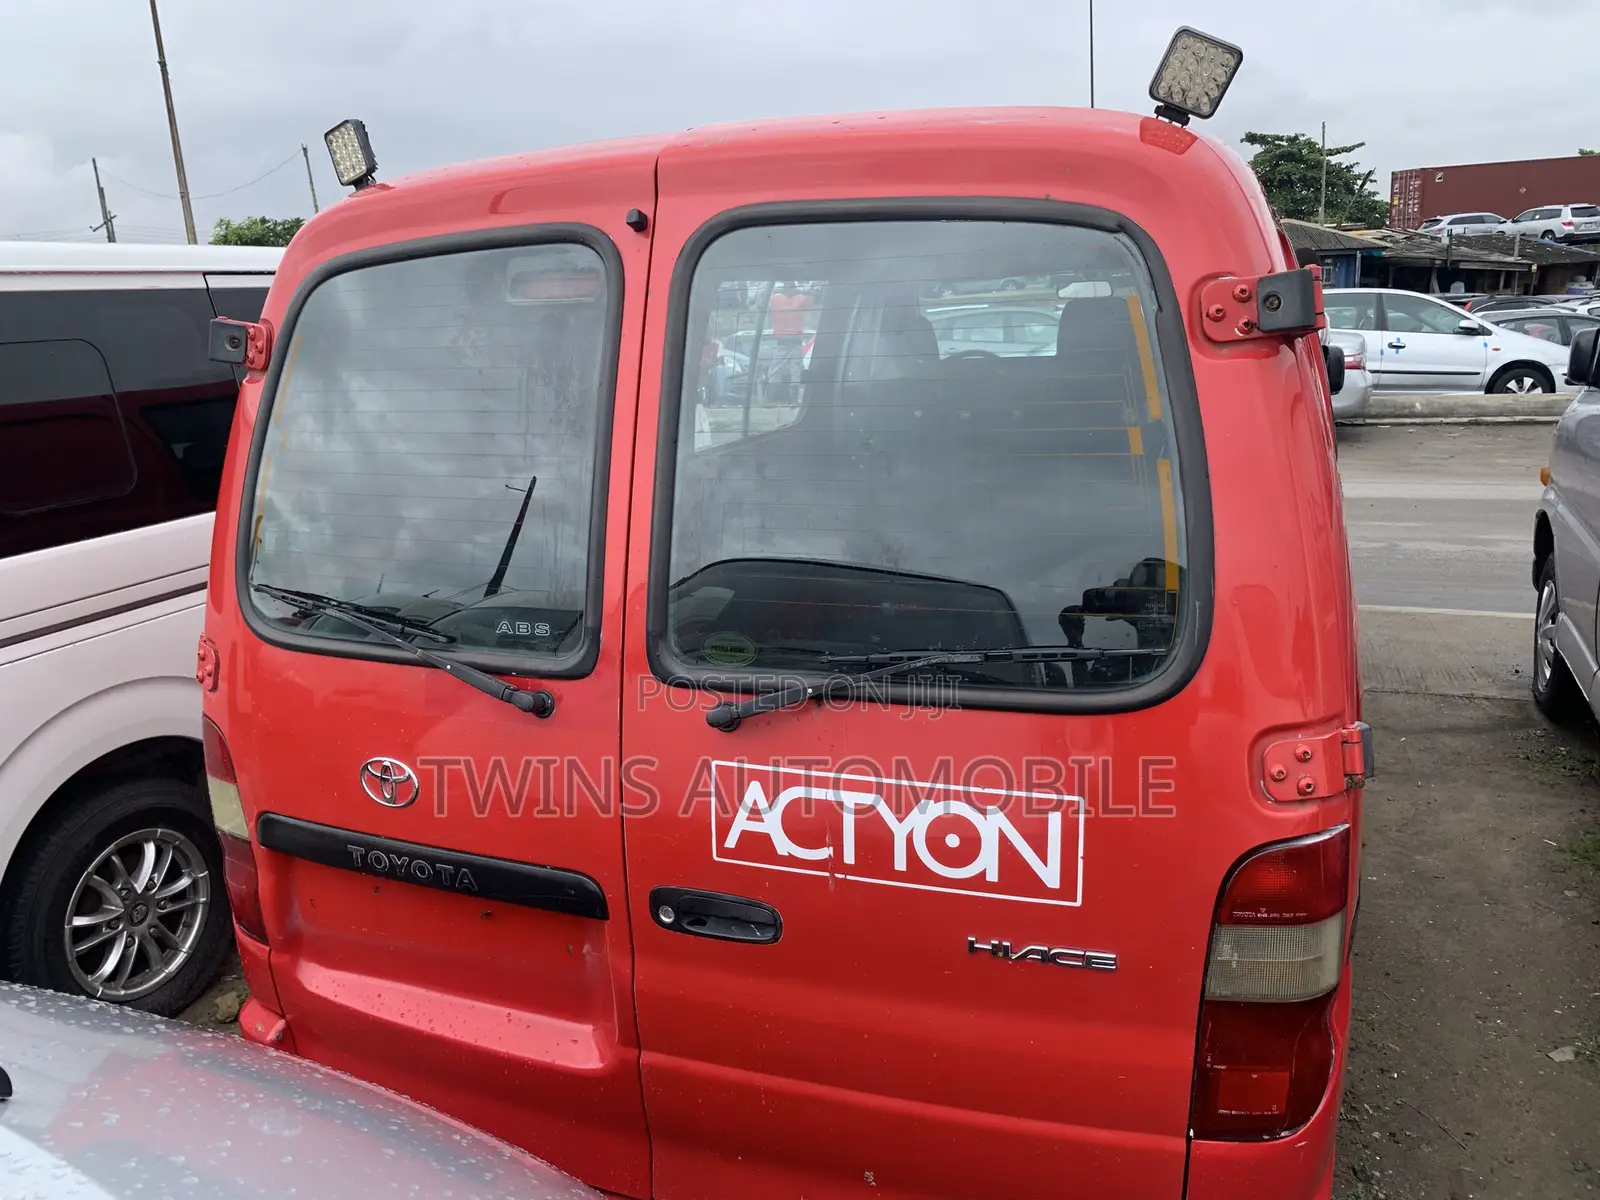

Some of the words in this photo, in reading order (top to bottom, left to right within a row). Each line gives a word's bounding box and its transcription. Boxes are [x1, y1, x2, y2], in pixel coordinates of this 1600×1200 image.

[496, 621, 550, 636] ABS
[724, 780, 1062, 889] ACTYON
[347, 845, 479, 892] TOYOTA
[967, 936, 1117, 970] HIACE
